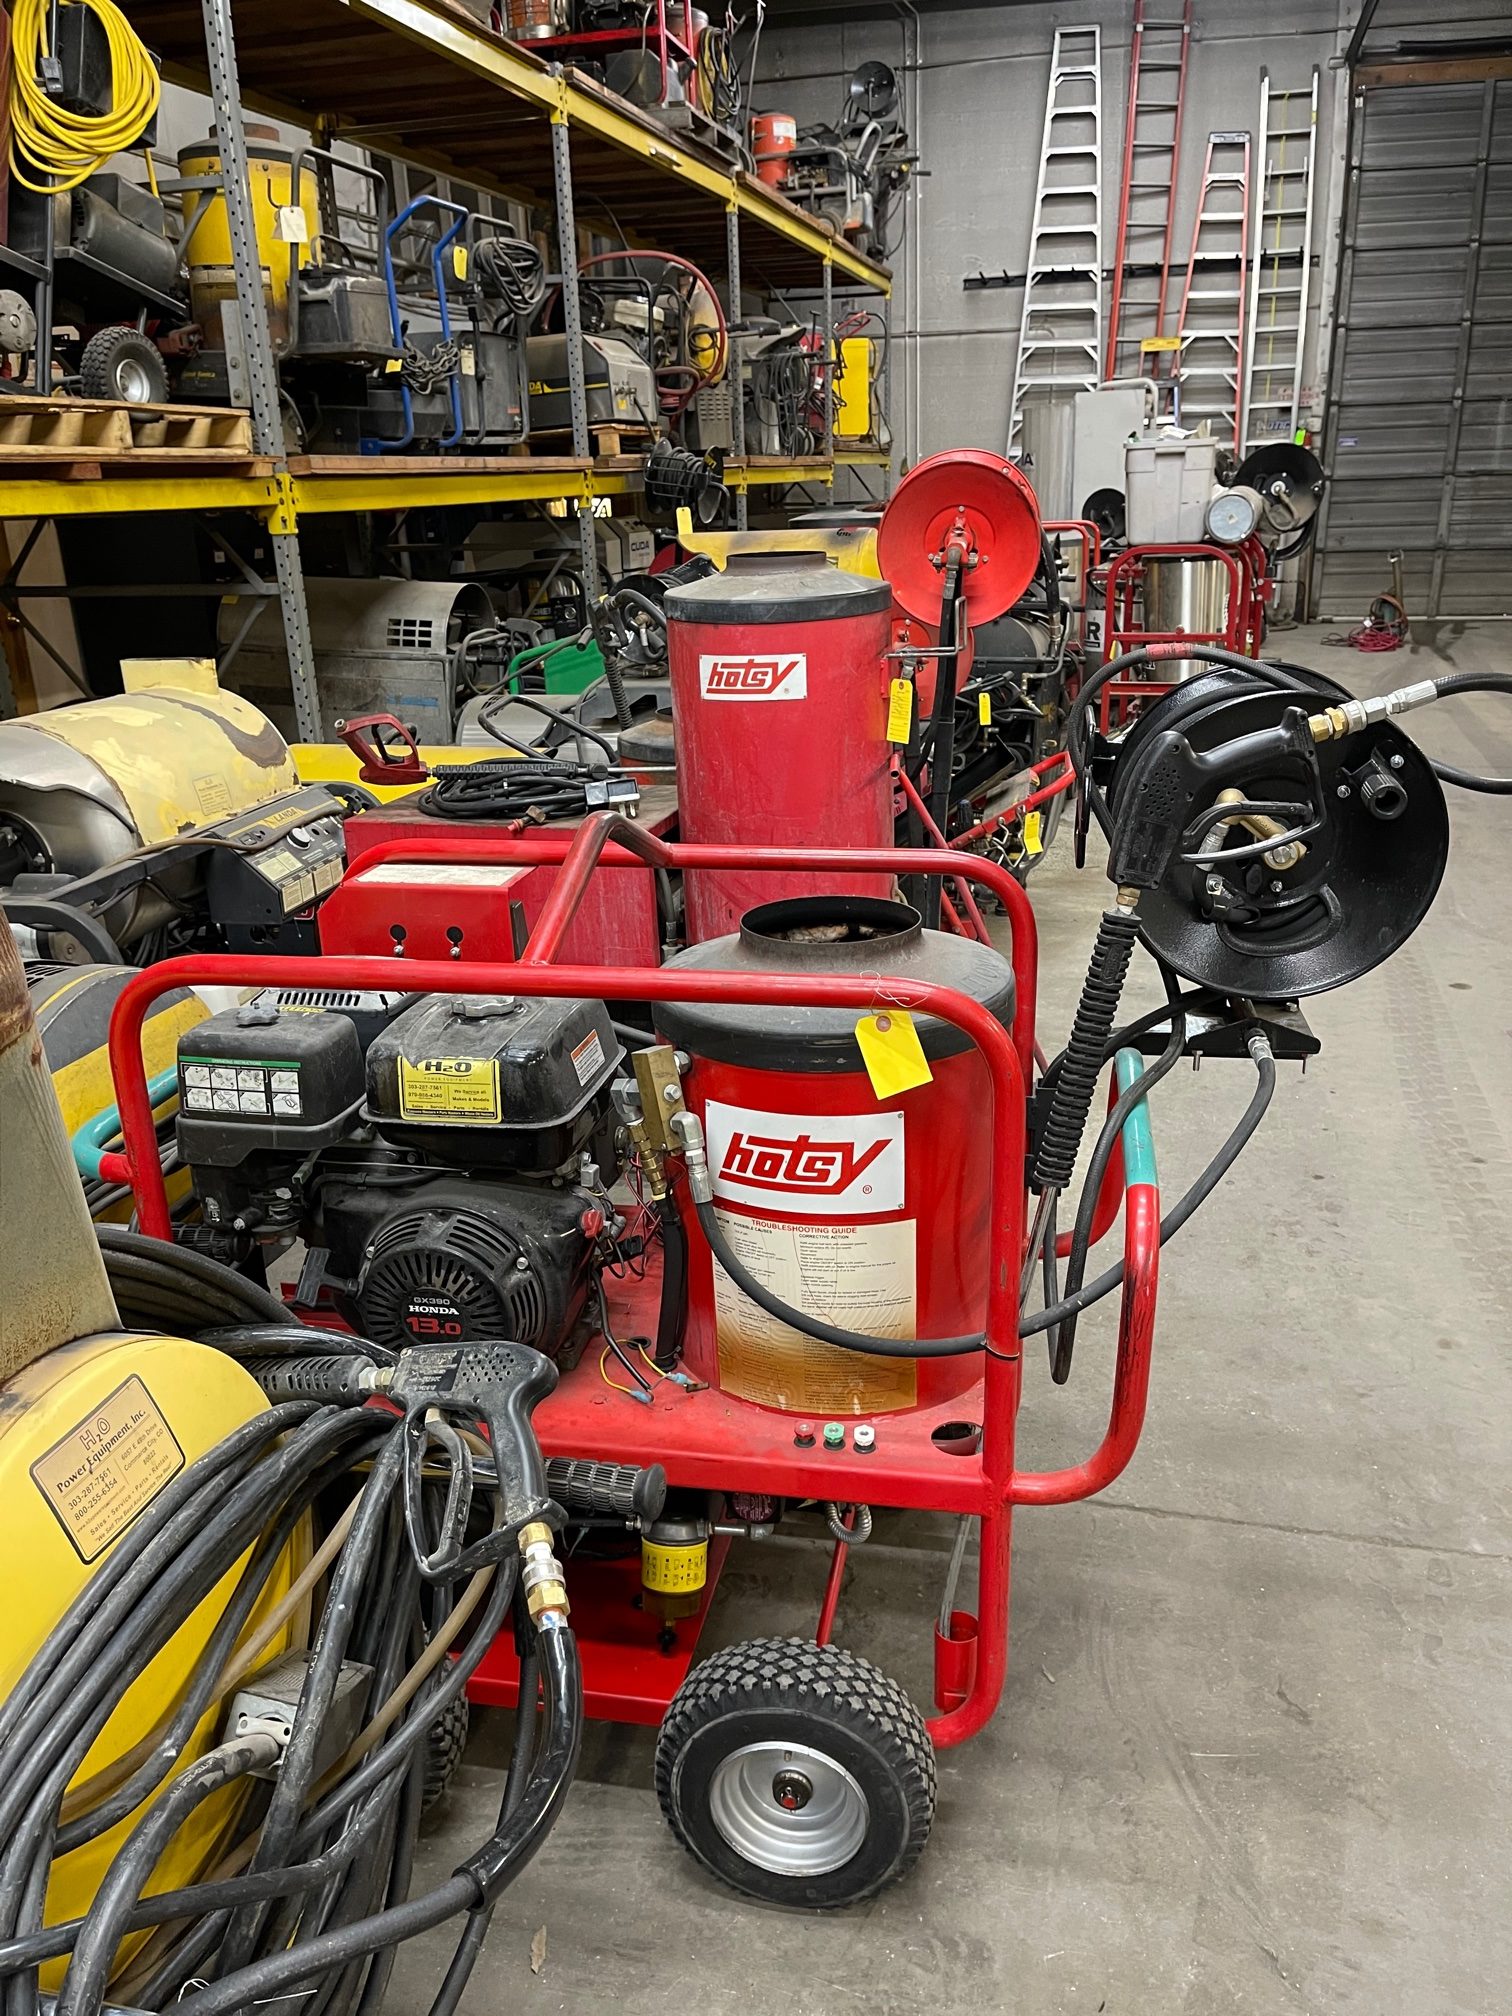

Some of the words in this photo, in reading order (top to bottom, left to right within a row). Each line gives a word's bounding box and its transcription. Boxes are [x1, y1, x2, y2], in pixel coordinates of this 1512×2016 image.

[274, 808, 297, 822] LANDA
[425, 1062, 472, 1073] H2O
[719, 1131, 893, 1195] hotsy
[752, 1219, 829, 1234] TROUBLESHOOTING
[408, 1305, 460, 1315] HONDA
[413, 1296, 450, 1305] GX390
[406, 1316, 461, 1335] 13.0
[80, 1417, 110, 1451] H2O
[56, 1464, 87, 1493] Power
[86, 1423, 133, 1465] Equipment,
[130, 1410, 146, 1424] Inc.
[68, 1467, 111, 1510] 303-287-7561
[74, 1478, 118, 1521] 800-255-6354
[90, 1520, 107, 1536] Sales
[111, 1495, 131, 1515] Service
